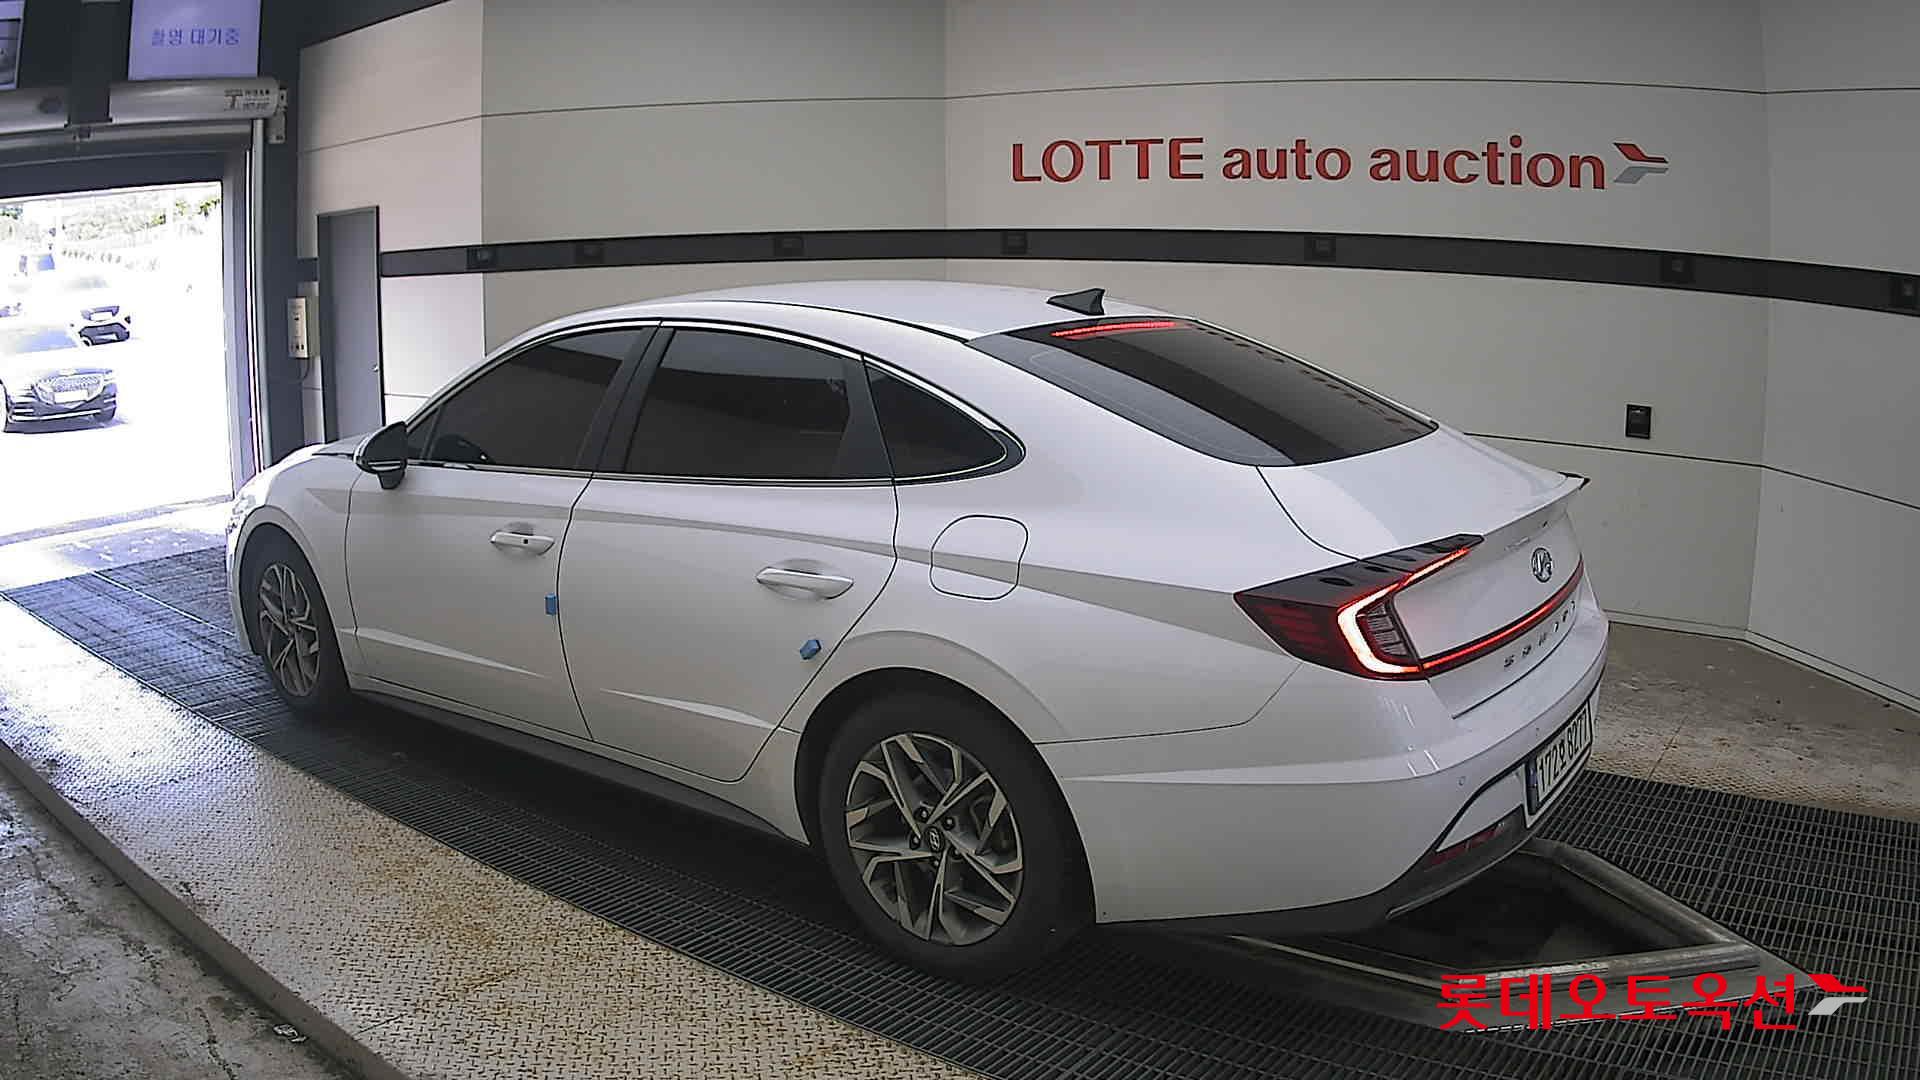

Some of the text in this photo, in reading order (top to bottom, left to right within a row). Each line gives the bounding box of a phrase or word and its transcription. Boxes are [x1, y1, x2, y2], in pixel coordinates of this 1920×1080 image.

[190, 27, 241, 46] 대기중
[1011, 134, 1606, 190] LOTTE auto auction
